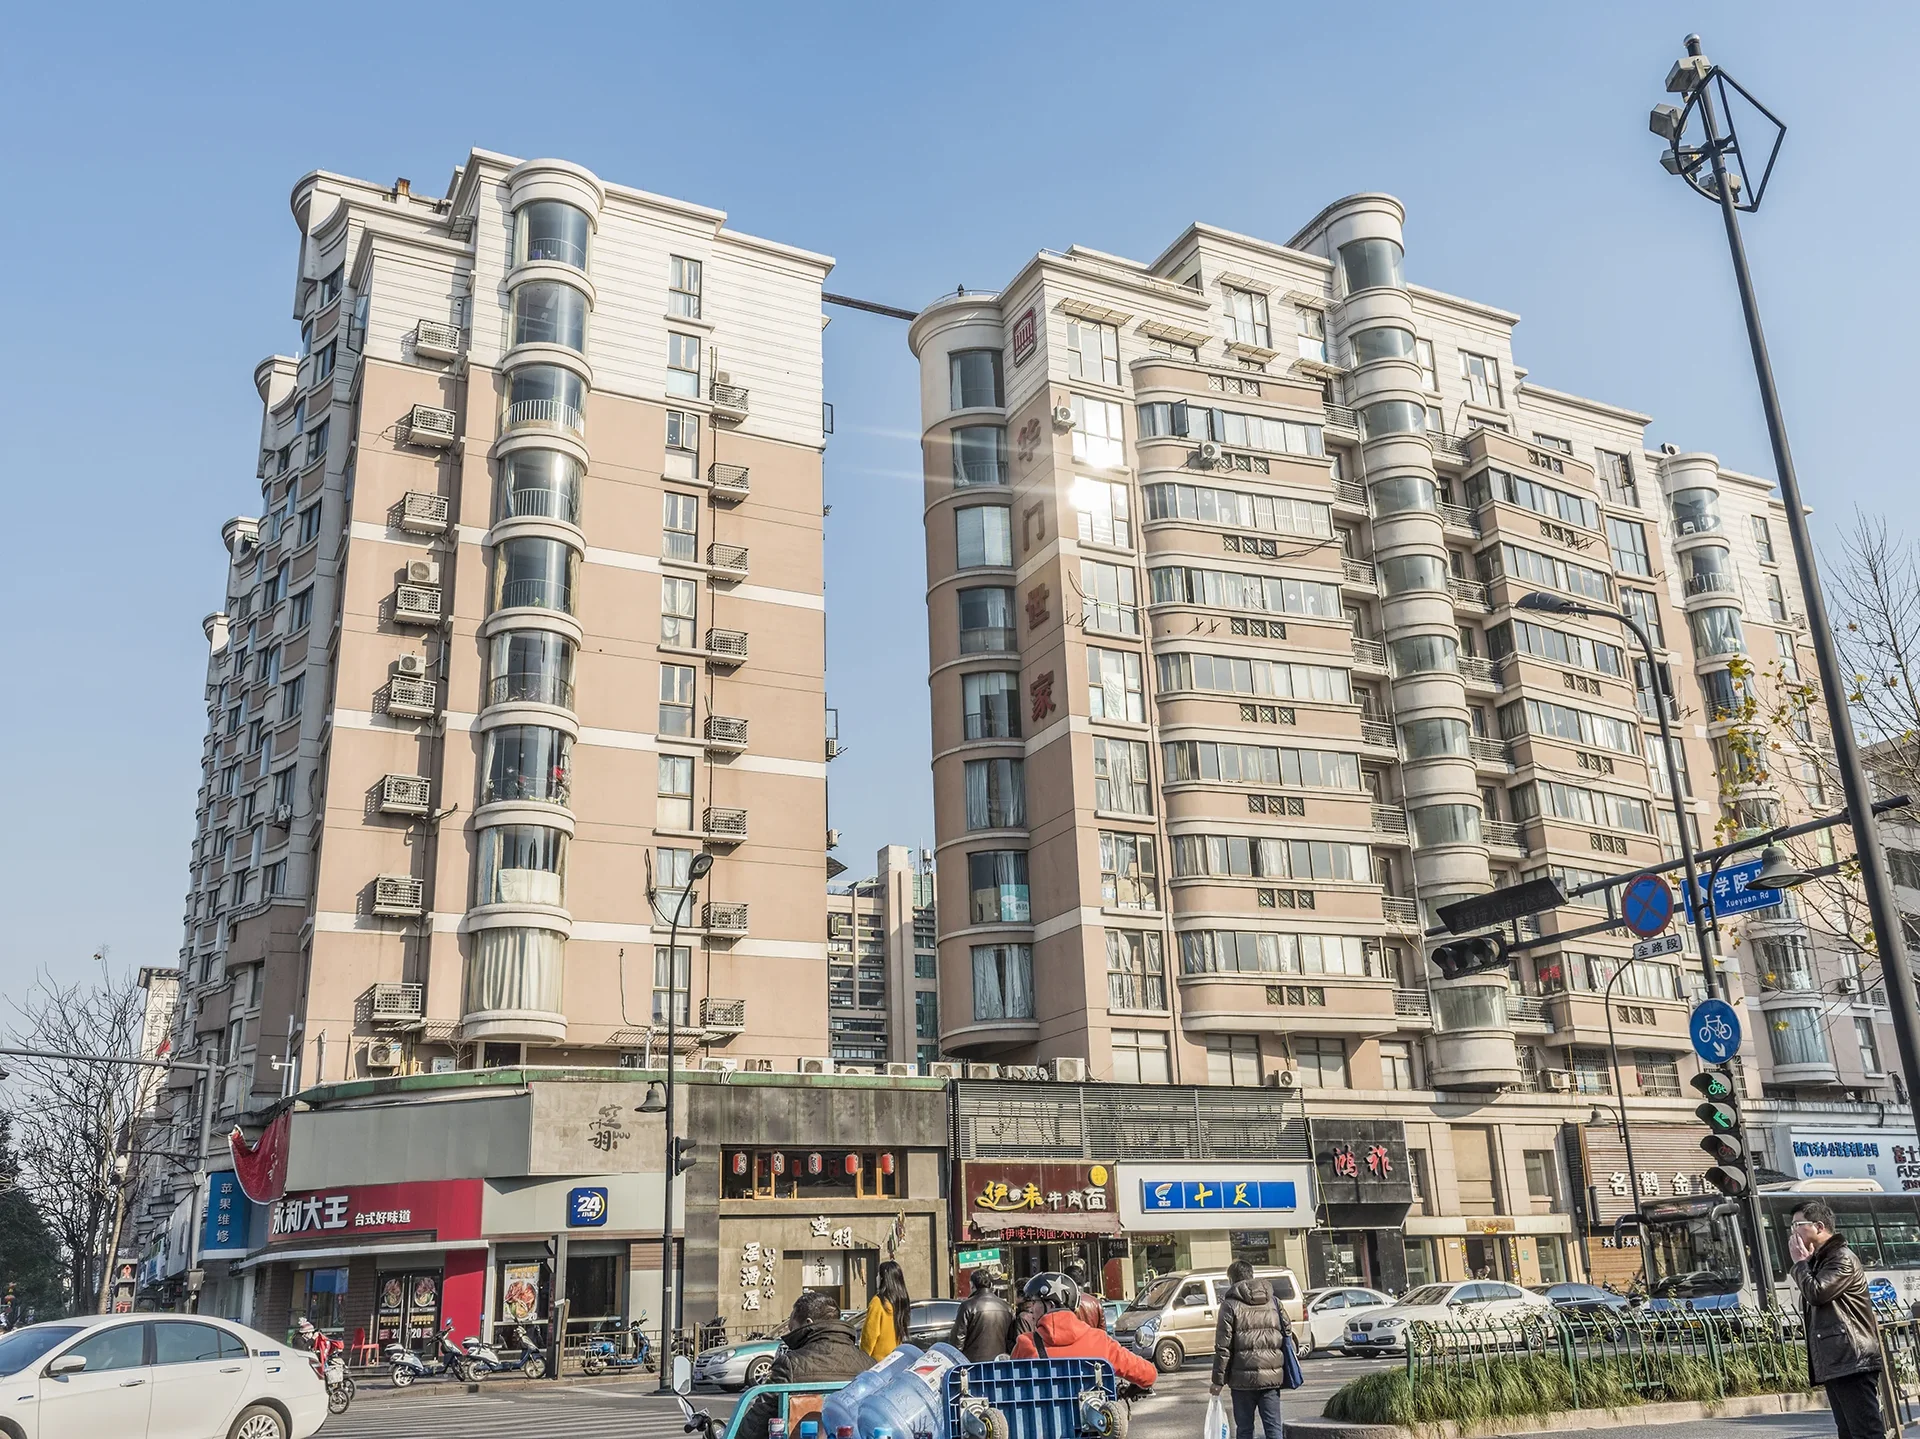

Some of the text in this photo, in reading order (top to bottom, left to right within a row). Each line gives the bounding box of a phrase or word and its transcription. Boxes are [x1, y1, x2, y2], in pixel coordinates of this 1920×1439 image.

[1016, 416, 1057, 722] 华门世家
[1725, 890, 1769, 908] Xueyuan Rd
[1637, 938, 1679, 957] 全路段
[577, 1196, 601, 1212] 24
[1194, 1182, 1251, 1207] 十足
[216, 1182, 233, 1243] 苹果维修
[272, 1195, 411, 1234] 永和大王 台式好味道
[811, 1215, 852, 1248] 空羽
[740, 1241, 760, 1311] 居酒屋
